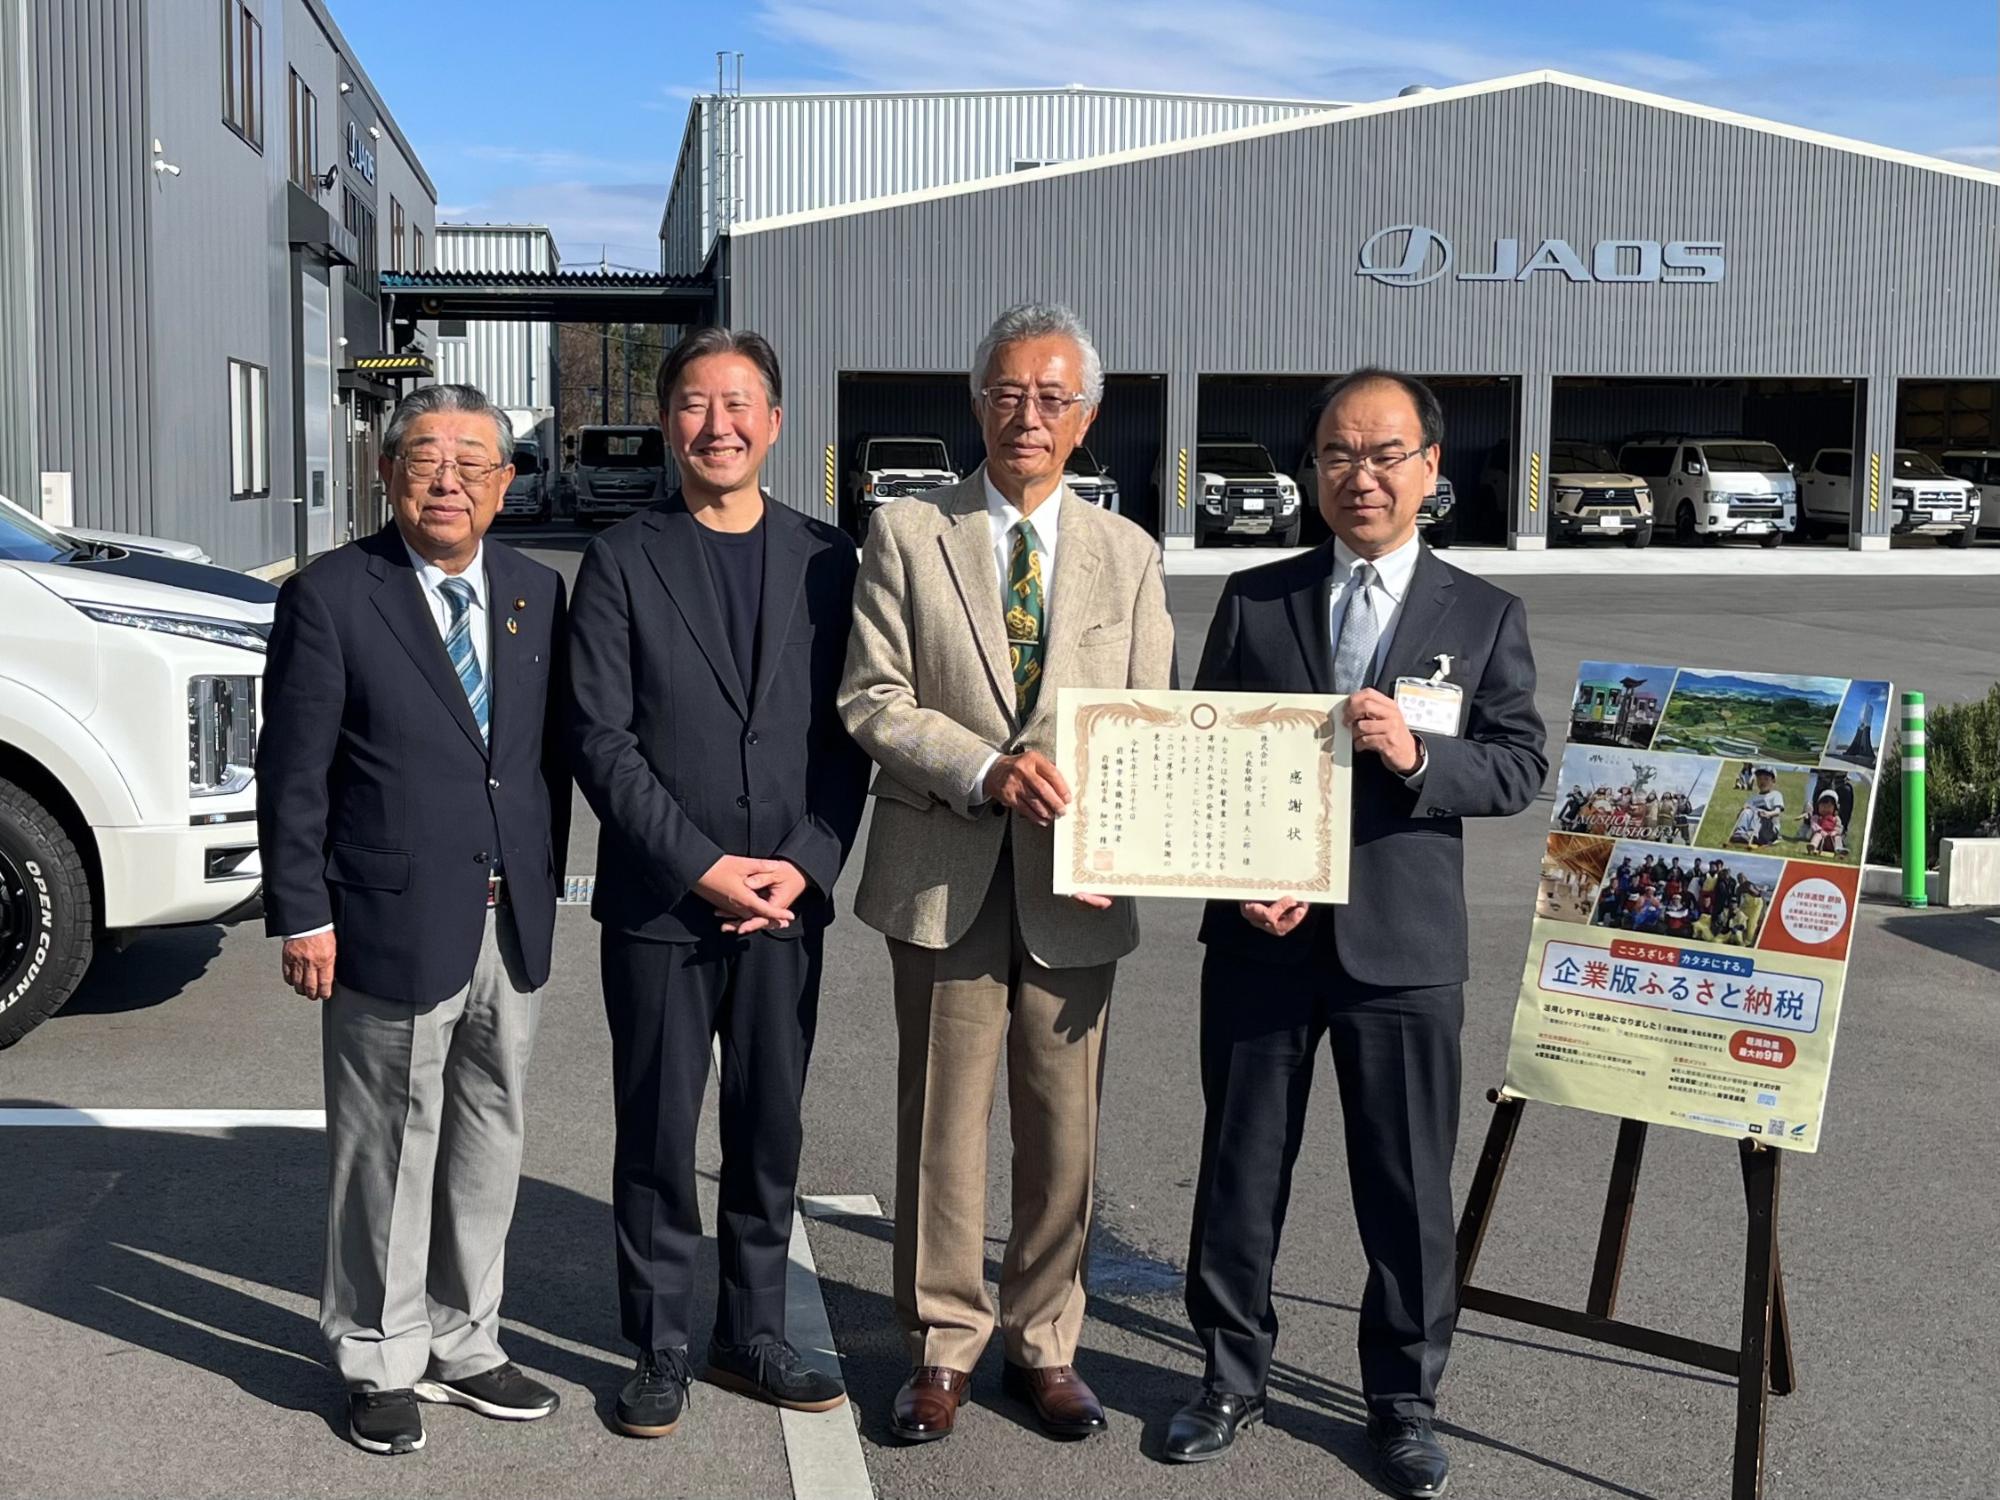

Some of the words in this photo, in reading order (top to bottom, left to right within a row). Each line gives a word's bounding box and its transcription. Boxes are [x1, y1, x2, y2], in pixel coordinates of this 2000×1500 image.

[1457, 239, 1725, 284] JAOS
[1180, 735, 1188, 775] あります
[1260, 735, 1269, 767] 株式会社
[1286, 769, 1303, 841] 感謝状
[25, 860, 53, 927] OPEN
[1618, 945, 1677, 963] こころざしを
[1680, 954, 1746, 974] カタチにする。
[1552, 956, 1805, 1020] 企業版ふるさと納税
[1738, 1047, 1784, 1063] 最大約9割
